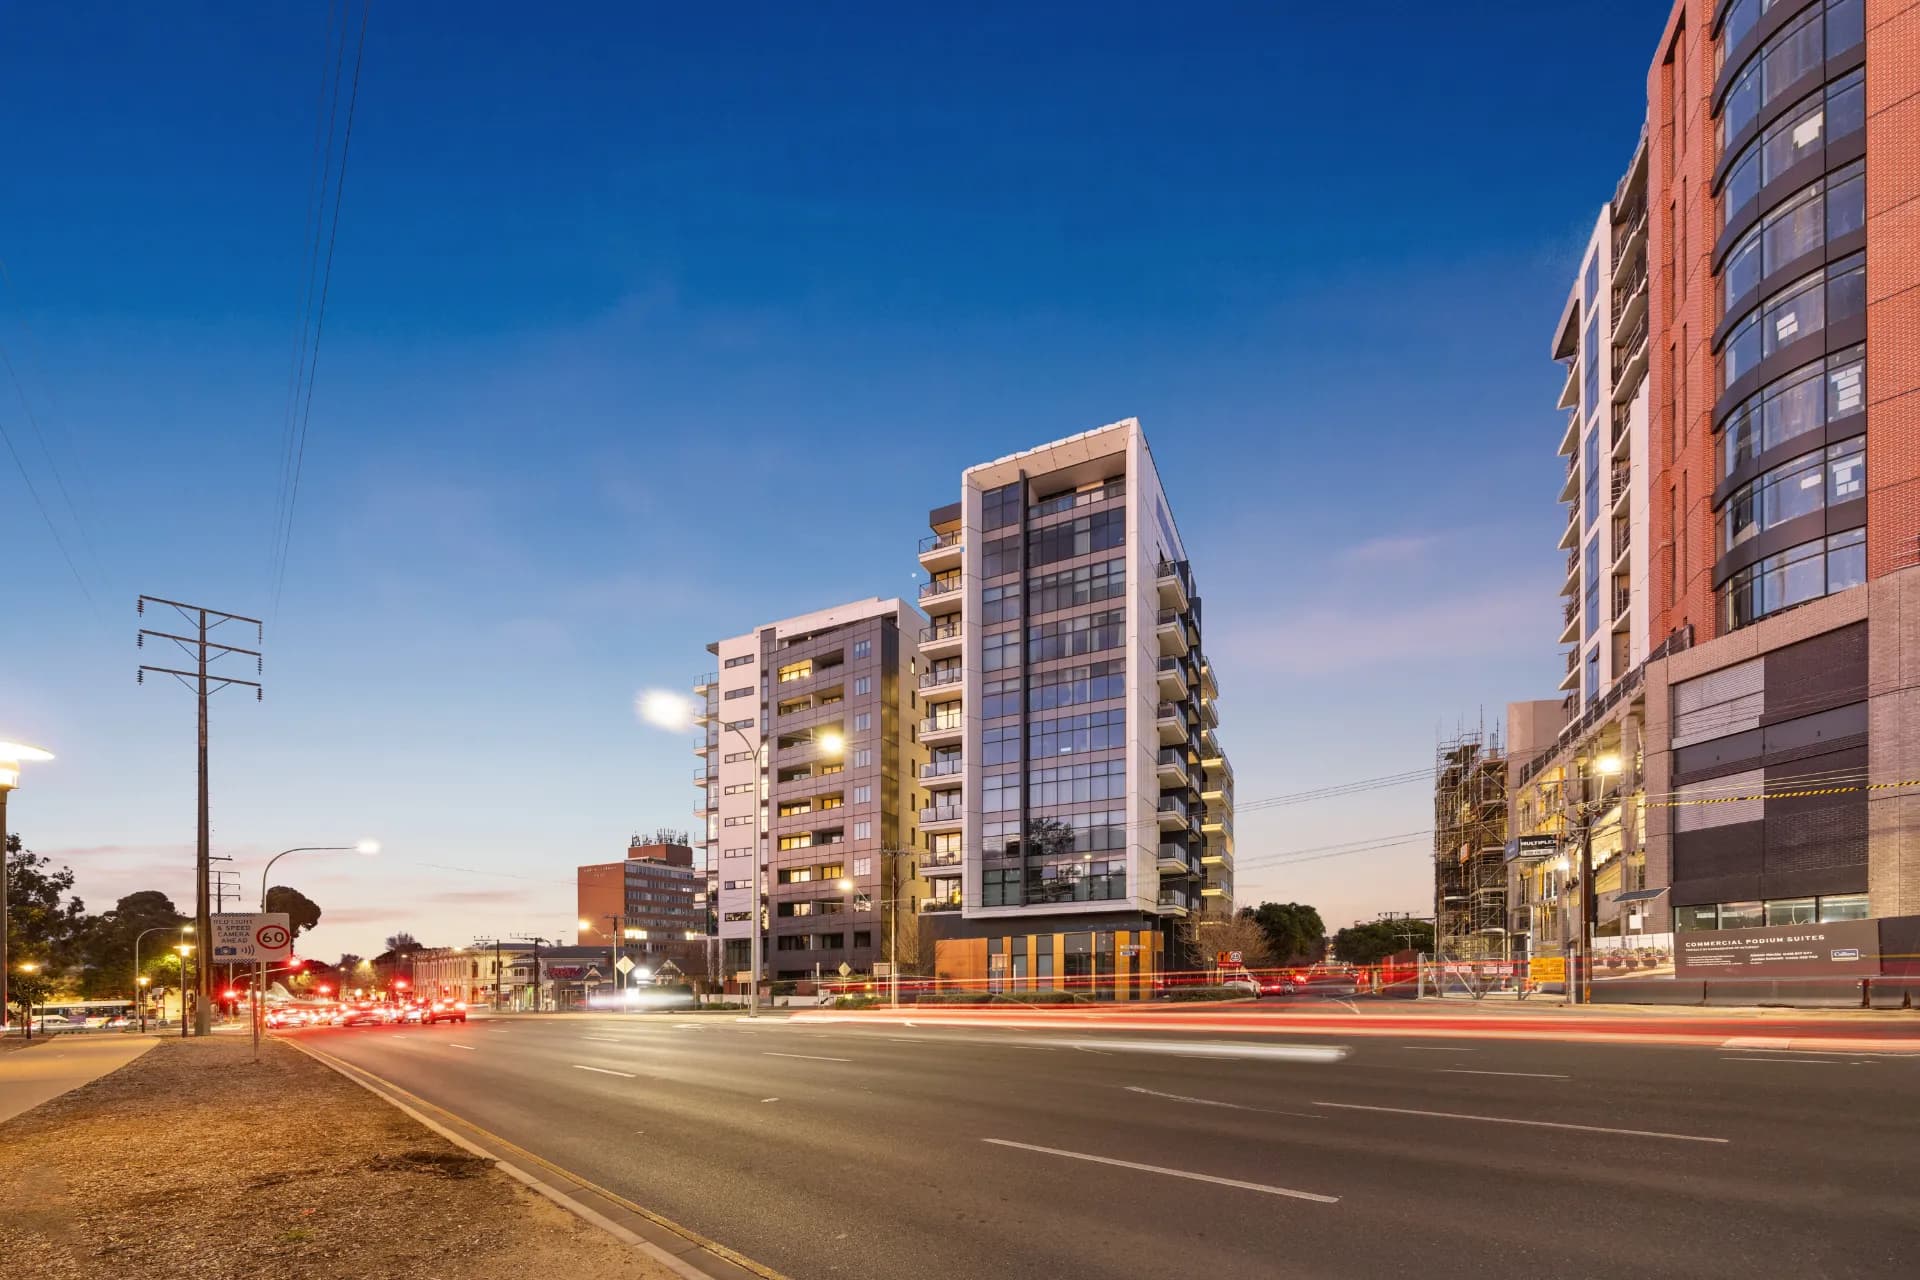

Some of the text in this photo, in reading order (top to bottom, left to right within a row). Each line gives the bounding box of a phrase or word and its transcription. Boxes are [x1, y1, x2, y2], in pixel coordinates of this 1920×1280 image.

[262, 932, 284, 943] 60
[1685, 934, 1825, 948] COMMERCIAL PODIUM SUITES
